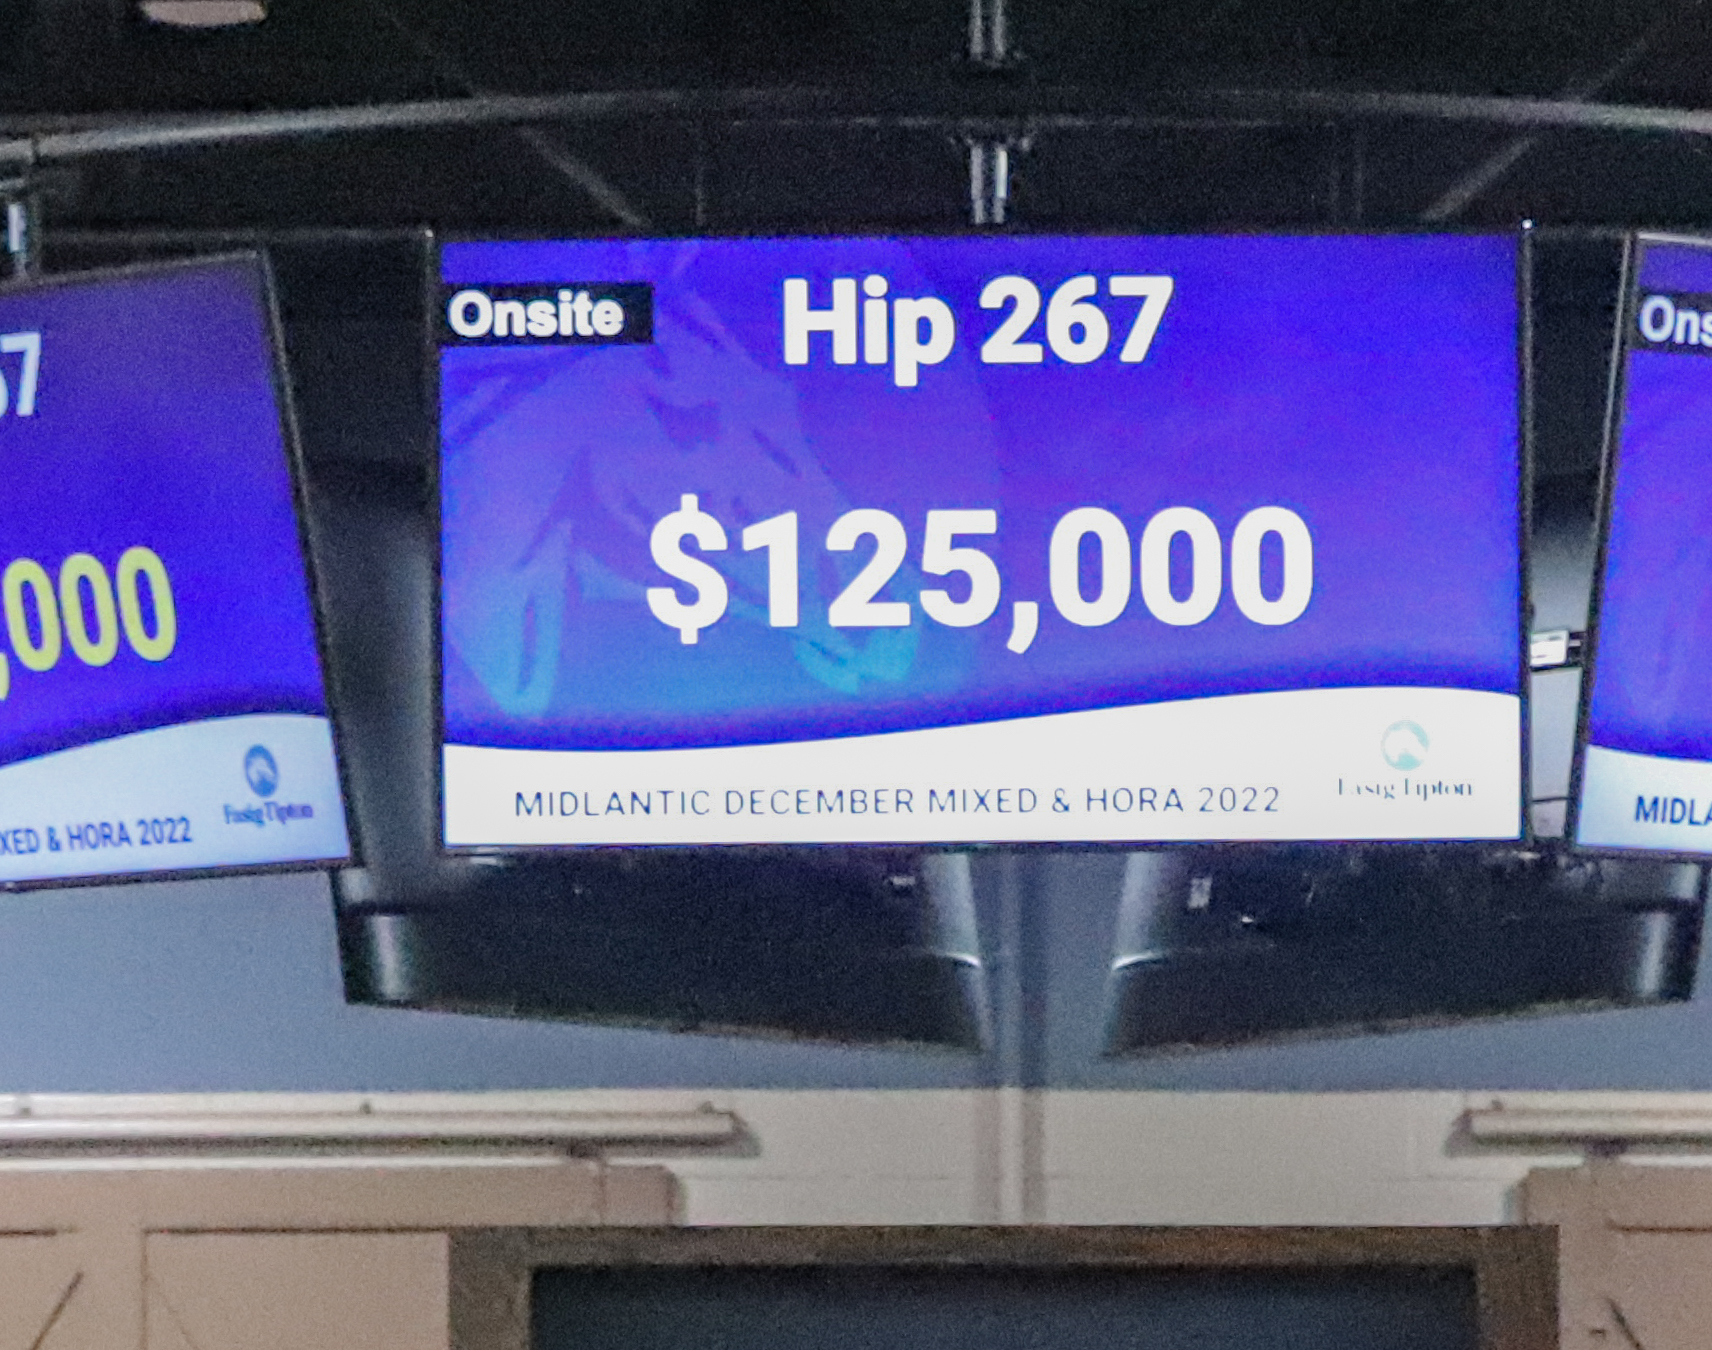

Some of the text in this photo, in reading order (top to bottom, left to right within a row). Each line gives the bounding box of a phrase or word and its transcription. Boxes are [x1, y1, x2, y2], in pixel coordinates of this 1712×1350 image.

[449, 288, 624, 338] Onsite
[783, 274, 1174, 388] Hip 267
[646, 493, 1314, 655] $125,000
[514, 786, 1280, 817] MIDLANTIC DECEMBER MIXED & HORA 2022
[46, 825, 62, 852] &
[65, 820, 132, 850] HORA
[136, 815, 193, 846] 2022
